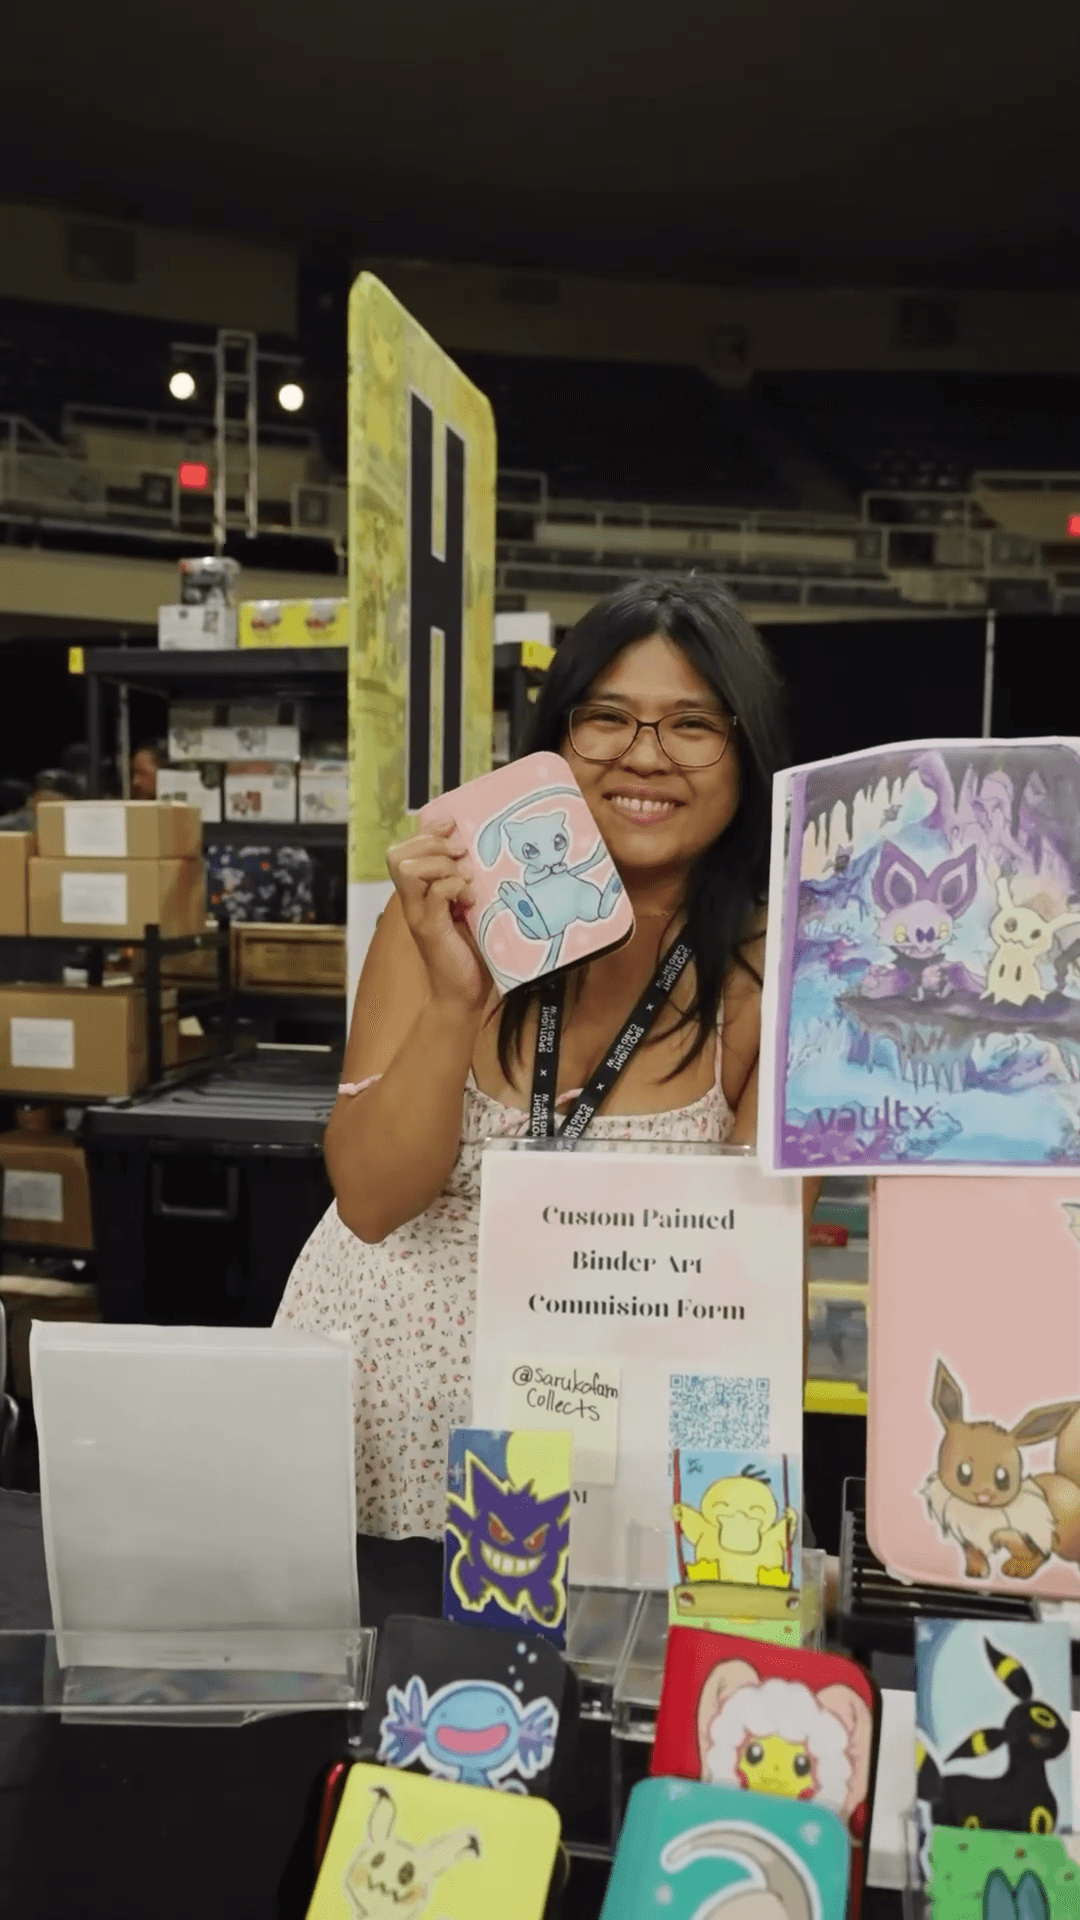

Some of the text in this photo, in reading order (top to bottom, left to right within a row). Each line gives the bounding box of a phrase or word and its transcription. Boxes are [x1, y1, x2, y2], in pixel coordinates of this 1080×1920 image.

[409, 388, 465, 811] H
[655, 944, 685, 988] CARD SHW
[539, 1006, 550, 1053] SPOTLIGHT
[547, 1005, 557, 1053] CARD SHW
[606, 1023, 637, 1068] CARD SHW
[613, 1026, 644, 1072] SPOTLIGHT
[541, 1093, 549, 1120] SHW
[570, 1103, 587, 1125] CARD
[542, 1206, 735, 1230] Custom Painted
[573, 1250, 702, 1274] Binder Art
[529, 1293, 746, 1321] Commision Form
[526, 1387, 600, 1422] Collects
